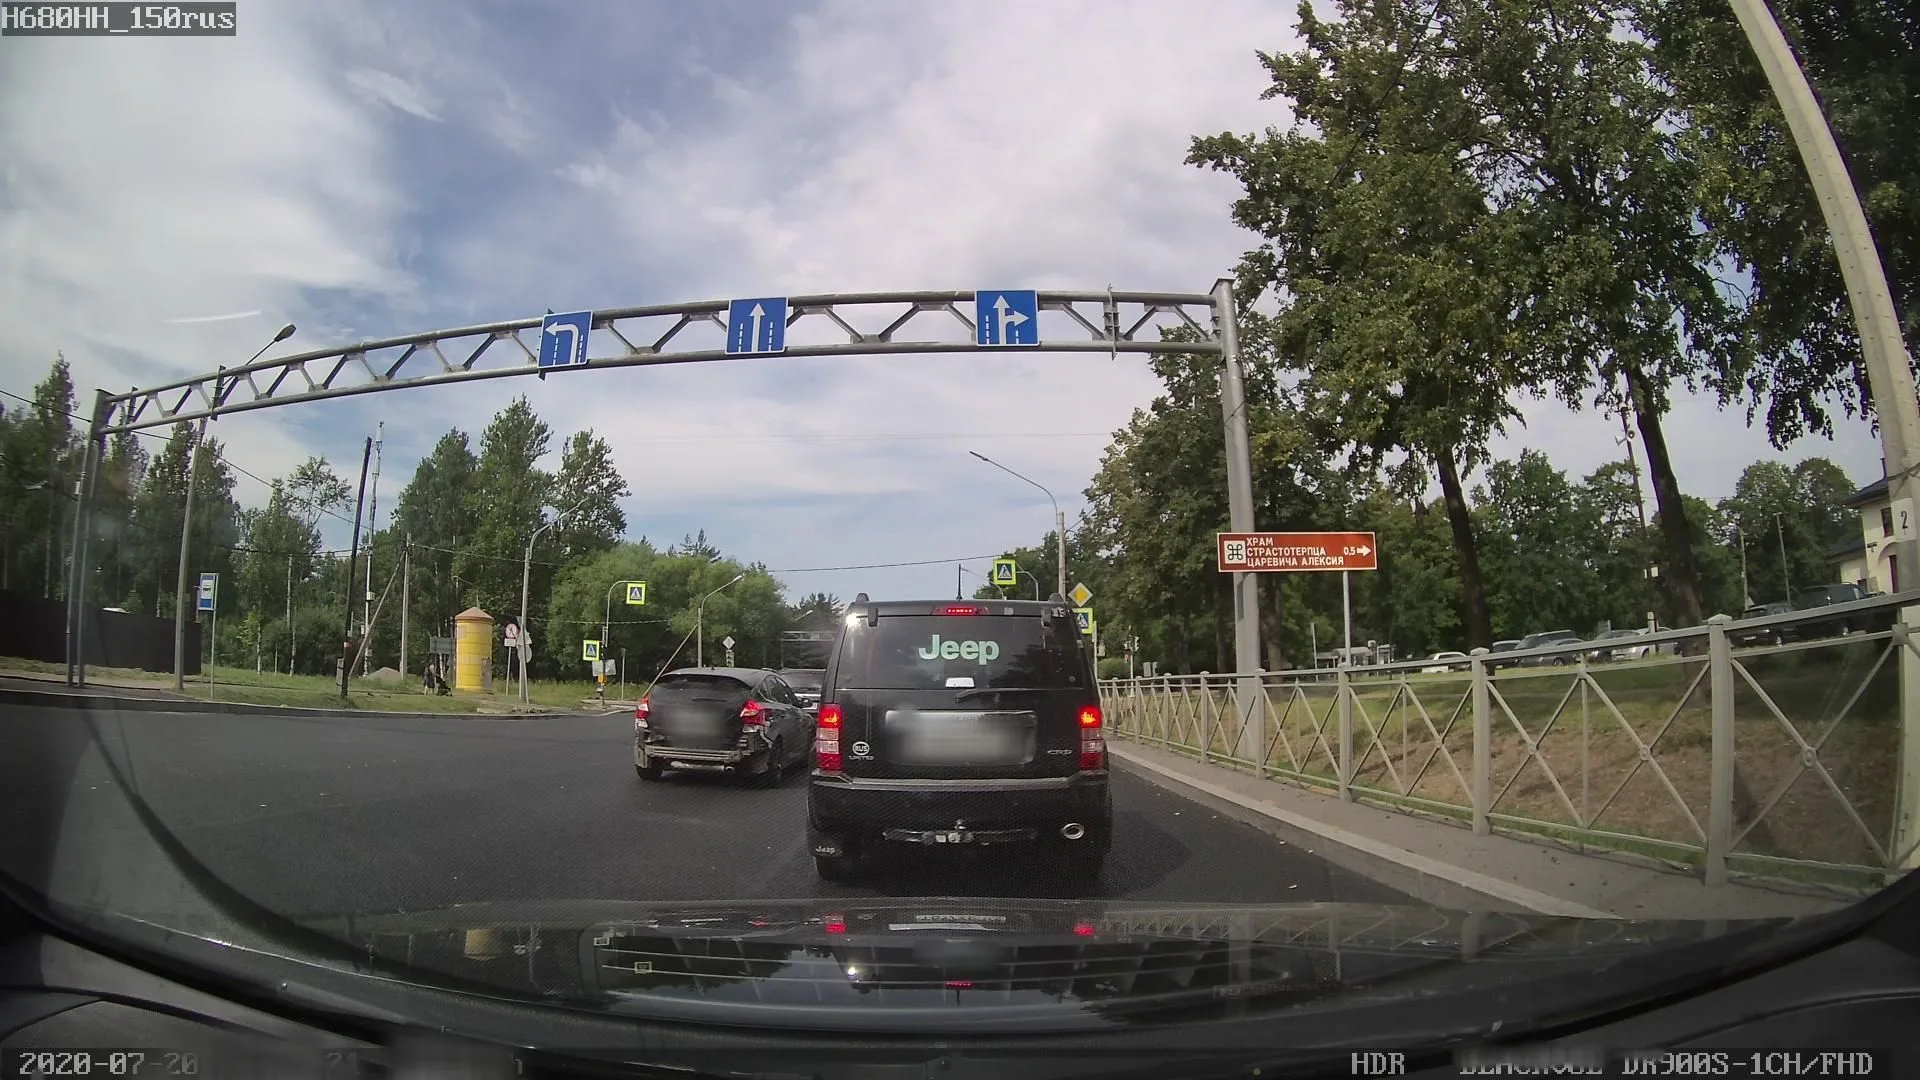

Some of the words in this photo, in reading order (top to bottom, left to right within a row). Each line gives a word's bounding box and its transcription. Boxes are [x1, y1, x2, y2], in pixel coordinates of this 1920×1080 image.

[1900, 510, 1908, 529] 2
[1246, 537, 1273, 546] ХРАМ
[1246, 547, 1326, 557] СТРАСТОТЕРПЦА
[1247, 557, 1298, 568] ЦАРЕВИЧА
[1301, 556, 1344, 566] АЛЕКСИЯ
[918, 634, 1000, 665] Jeep
